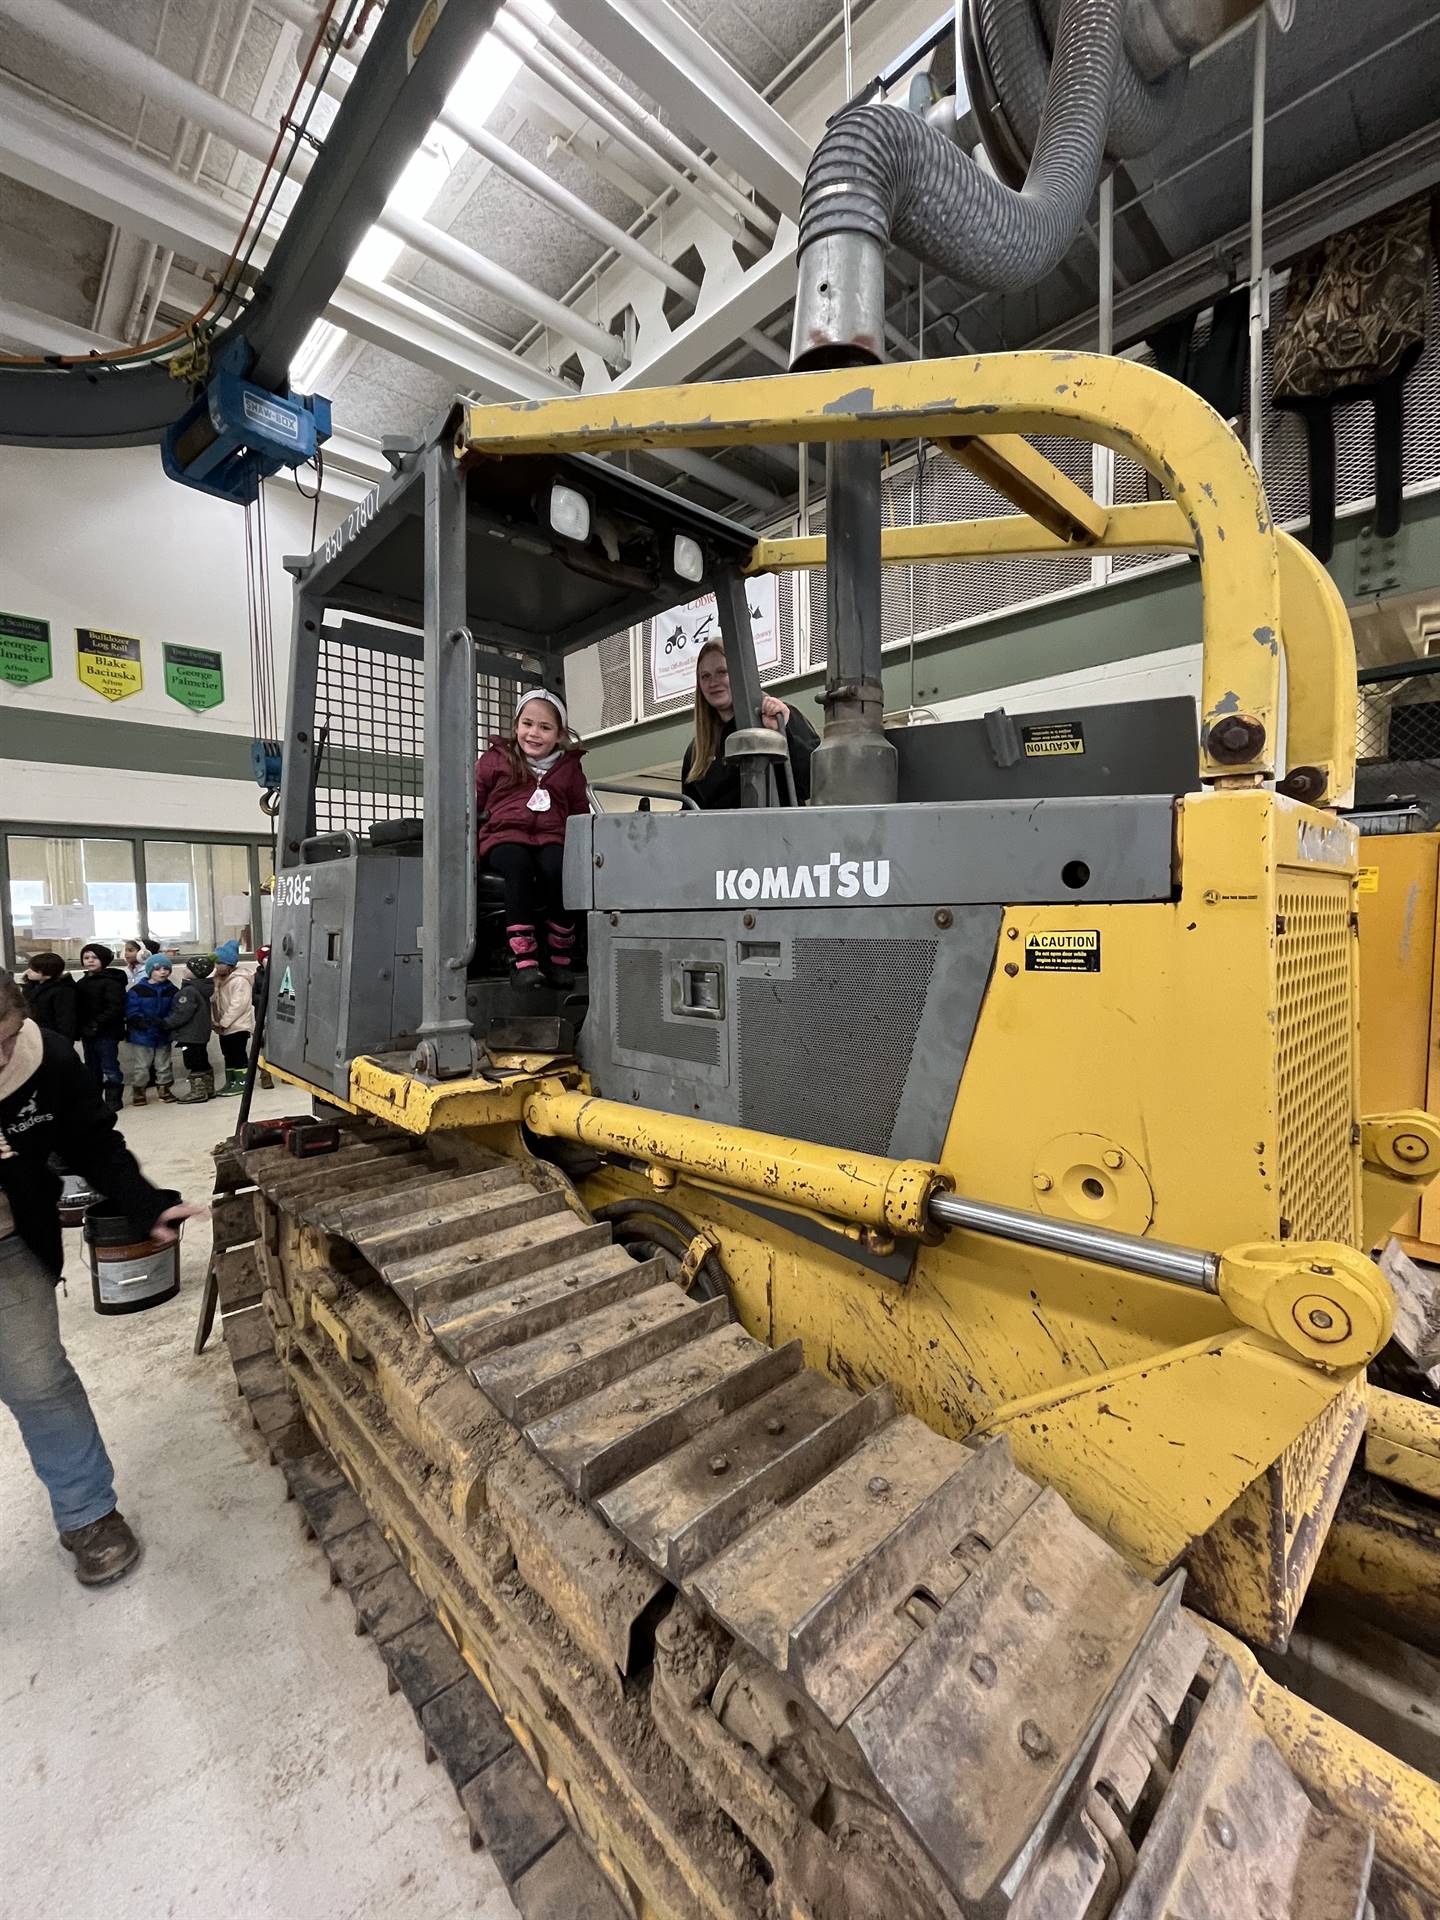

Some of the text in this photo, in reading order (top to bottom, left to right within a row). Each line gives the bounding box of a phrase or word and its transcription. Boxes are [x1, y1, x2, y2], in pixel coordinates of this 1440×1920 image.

[246, 399, 295, 430] SHAW-BOX
[88, 631, 129, 646] Bulldozer
[92, 640, 128, 652] Log Roll
[95, 656, 127, 669] Blake
[5, 673, 28, 682] 2022
[86, 666, 136, 681] Baciuska
[176, 667, 213, 680] George
[171, 676, 219, 690] Palmetier
[102, 687, 123, 695] 2022
[1028, 742, 1069, 752] CAUTION
[715, 852, 890, 900] KOMATSU
[1041, 936, 1095, 948] CAUTION
[6, 1113, 55, 1135] Raiders
